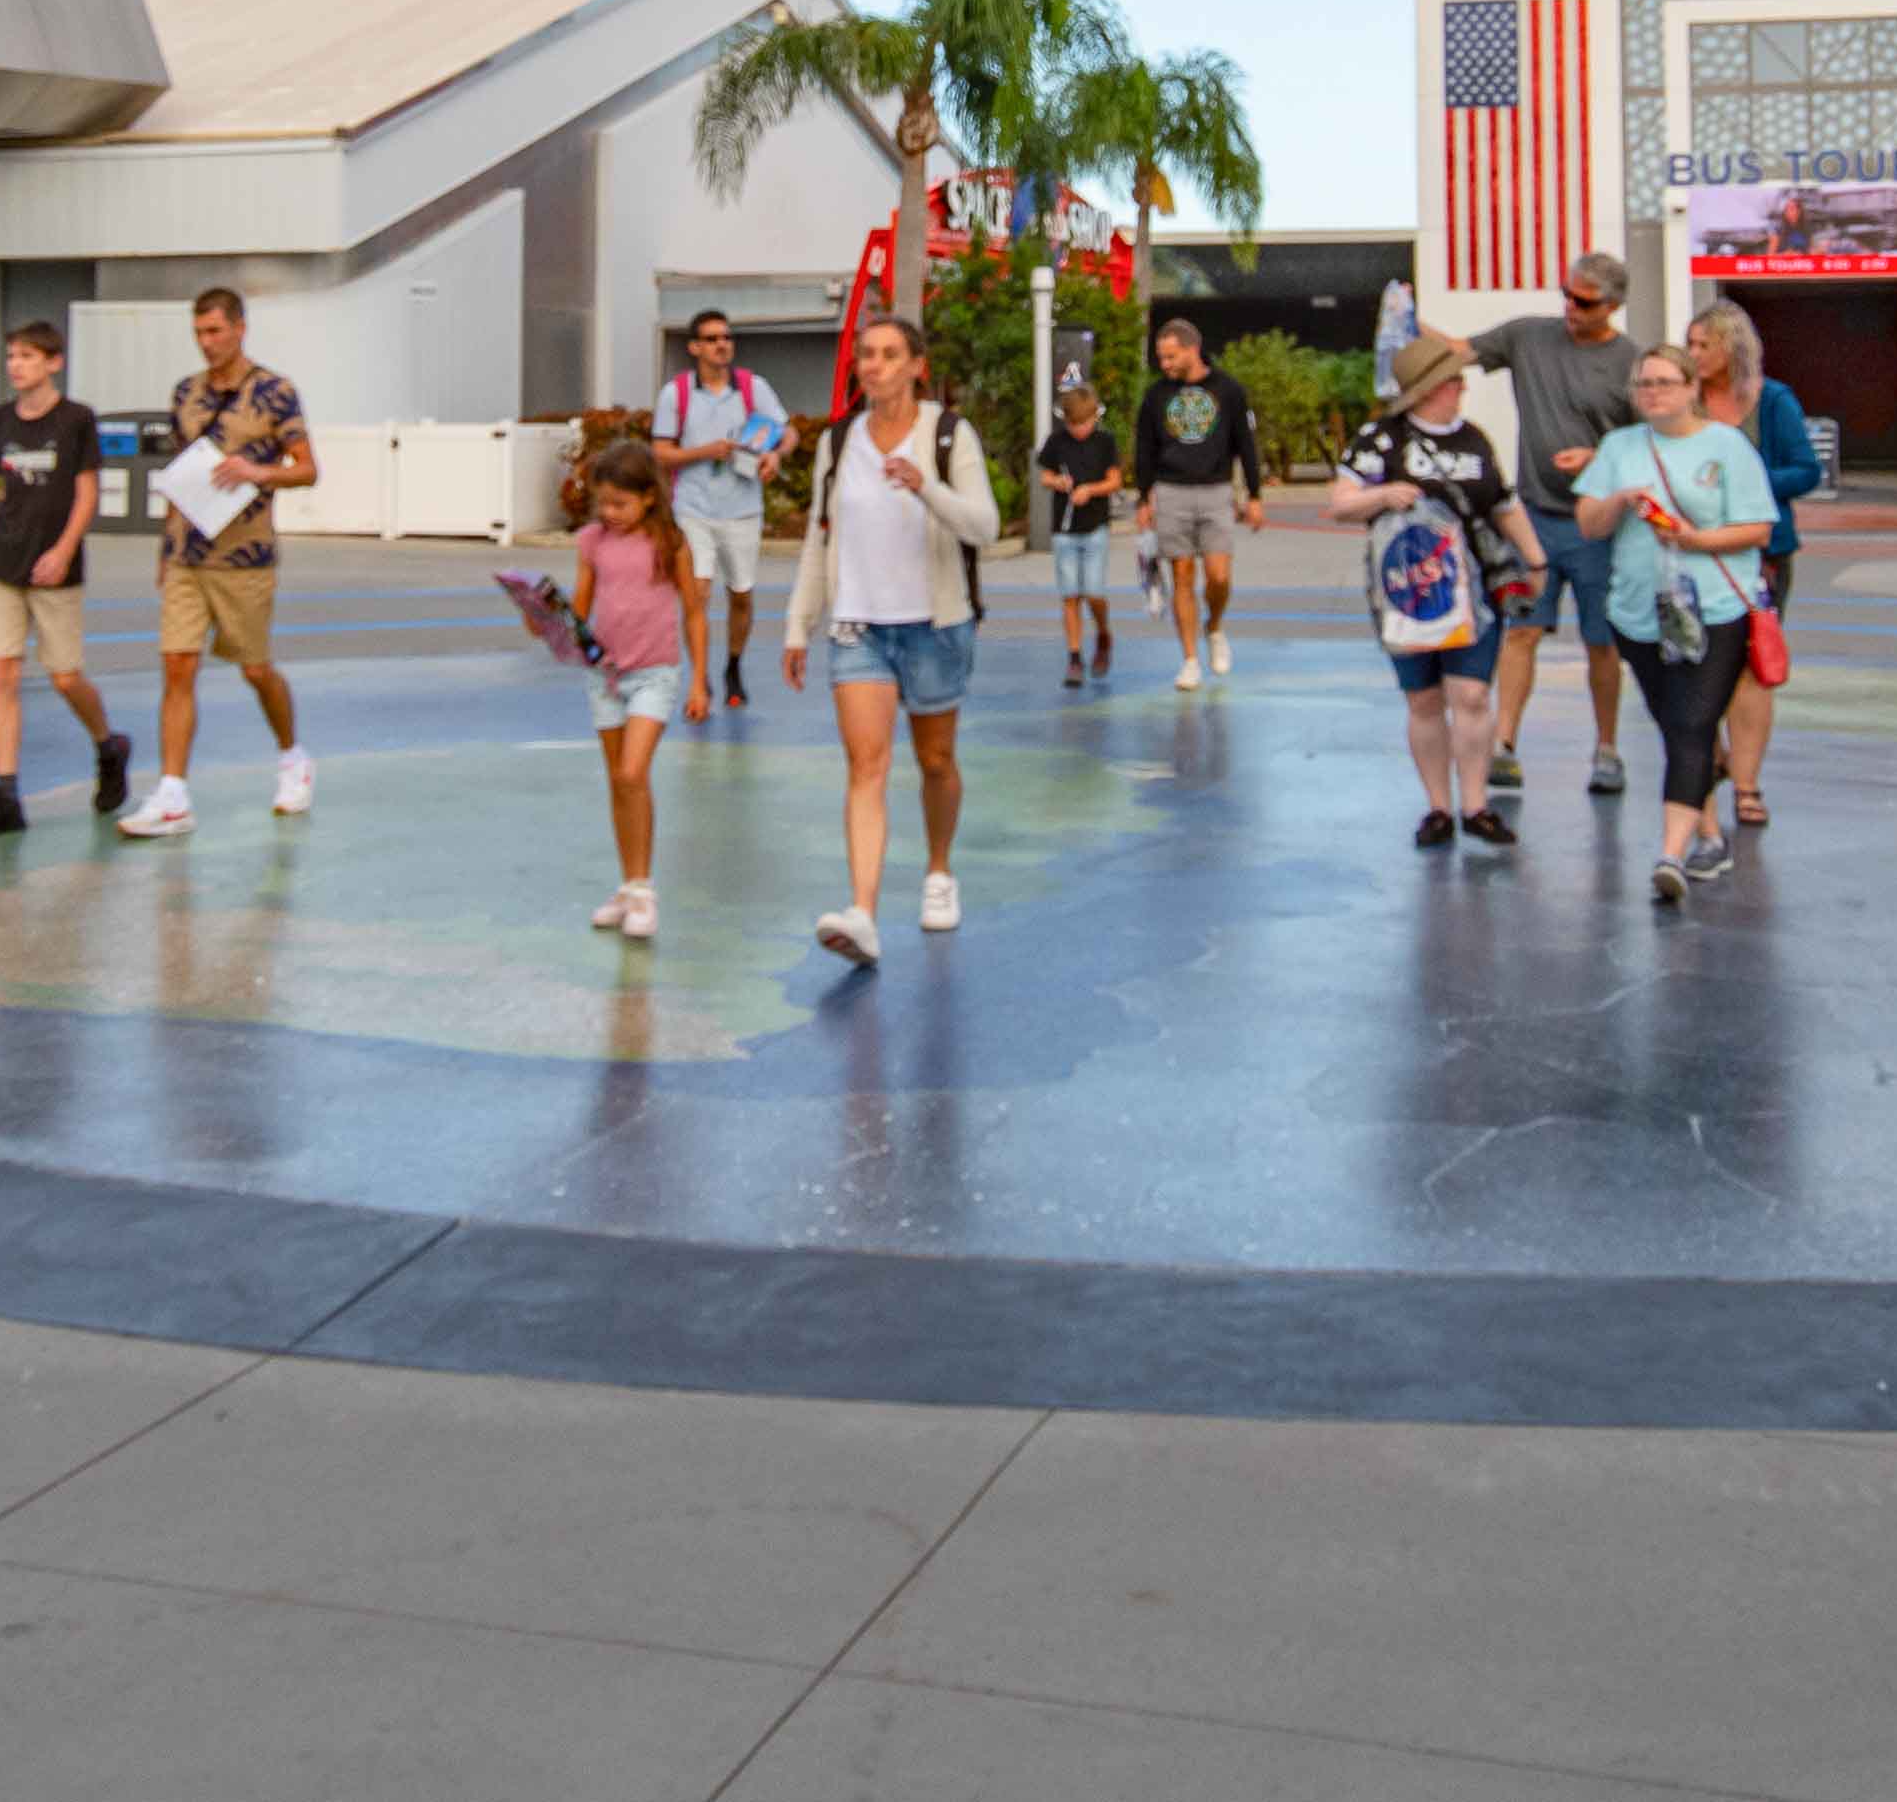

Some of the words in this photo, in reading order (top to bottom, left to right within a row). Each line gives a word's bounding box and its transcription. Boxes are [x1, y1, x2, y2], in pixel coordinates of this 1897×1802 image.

[1668, 152, 1763, 187] BUS
[1735, 258, 1764, 273] BUS
[1767, 258, 1815, 272] TOURS
